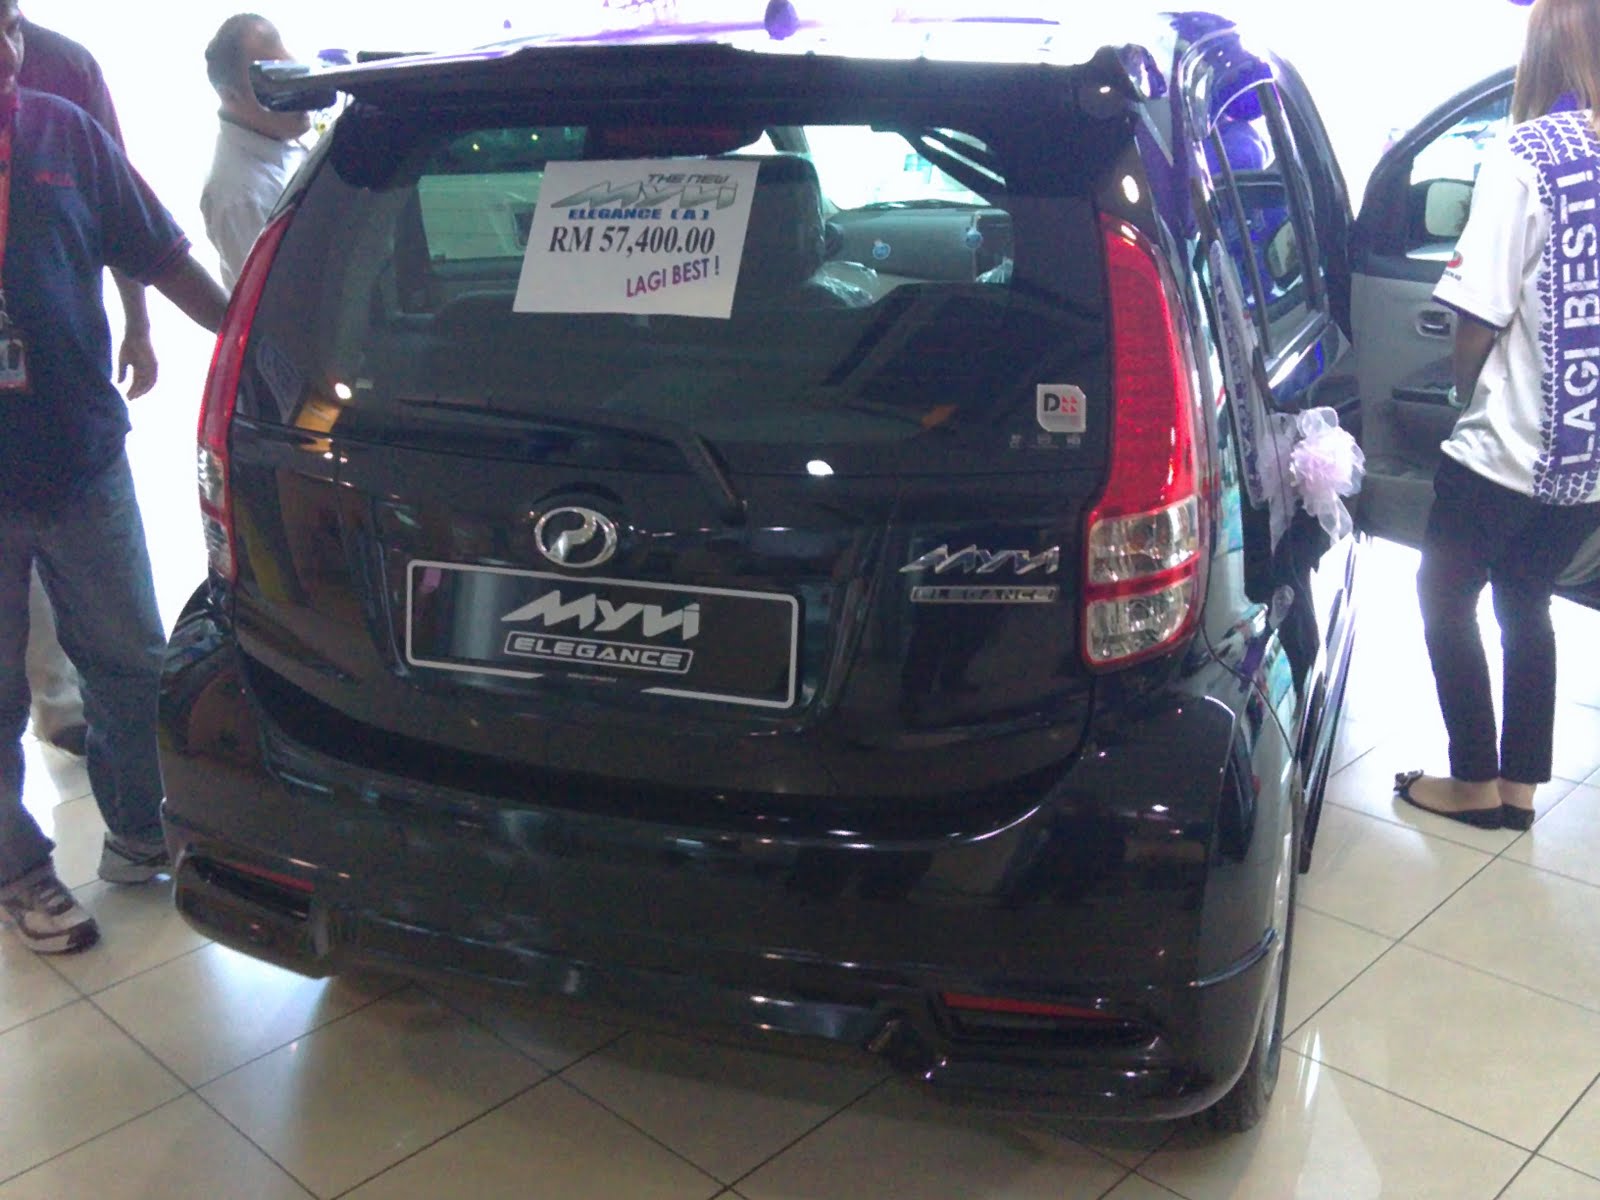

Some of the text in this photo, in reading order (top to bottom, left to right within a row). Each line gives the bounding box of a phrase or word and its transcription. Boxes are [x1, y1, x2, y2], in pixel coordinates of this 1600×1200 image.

[648, 173, 685, 184] THE
[568, 208, 662, 220] ELEGANCE
[549, 226, 715, 257] RM 57,400.00
[626, 268, 667, 298] LAGI
[1561, 347, 1600, 466] LAGI
[513, 636, 683, 668] ELEGANCE
